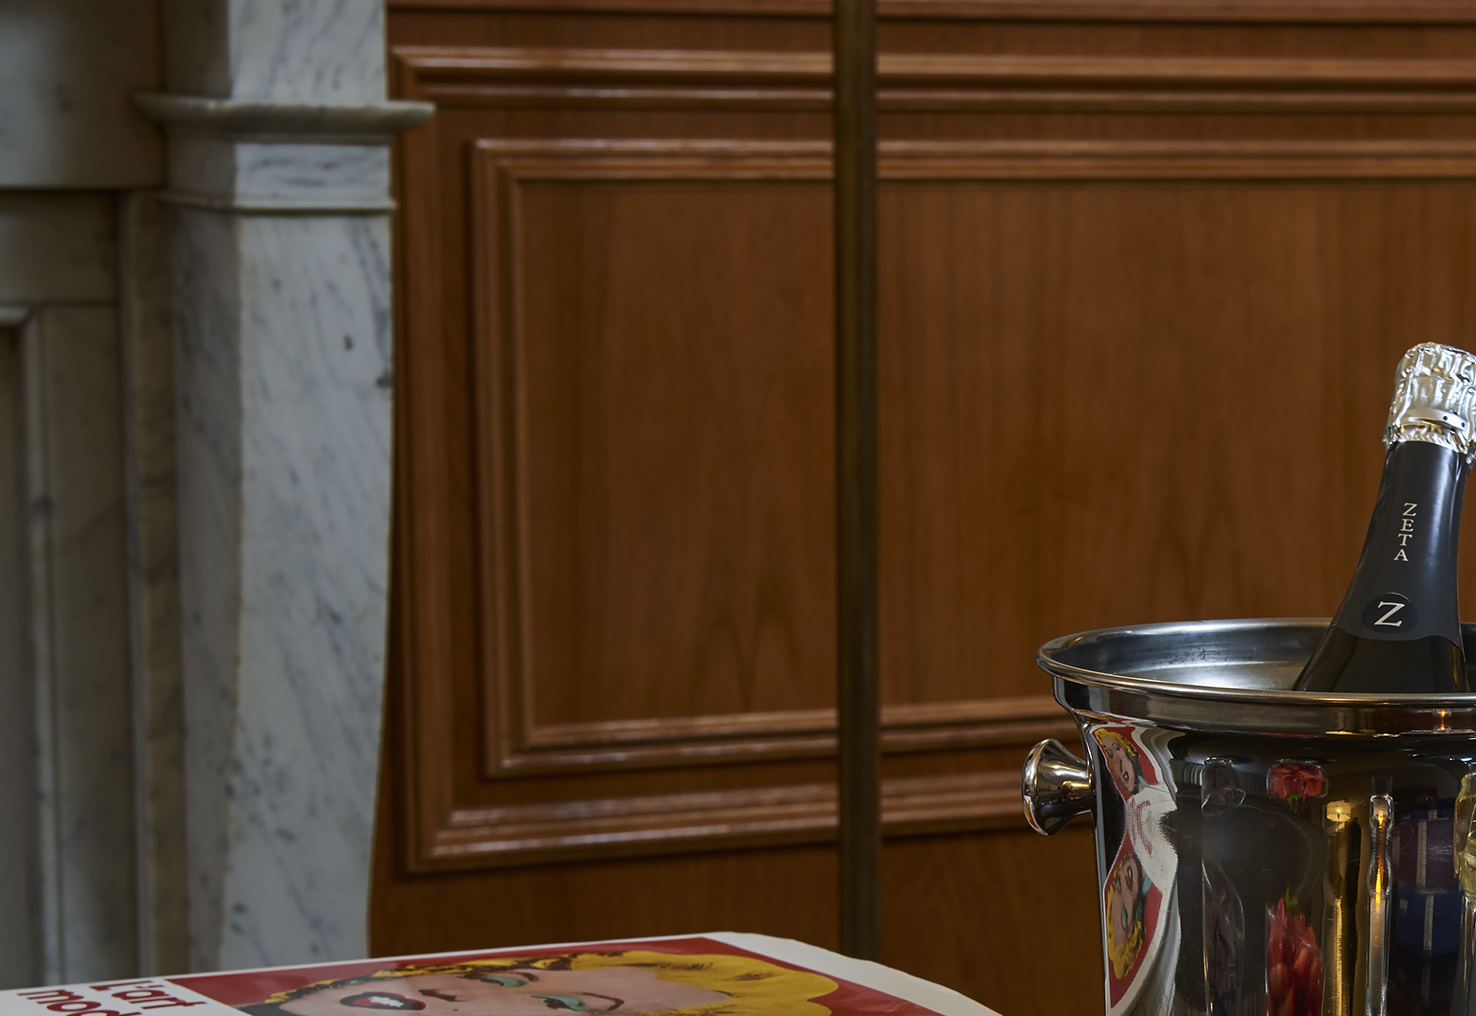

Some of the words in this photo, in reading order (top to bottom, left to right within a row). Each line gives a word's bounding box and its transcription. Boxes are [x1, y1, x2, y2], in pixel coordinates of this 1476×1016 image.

[1393, 502, 1418, 562] ZETA
[1373, 600, 1406, 628] Z
[89, 980, 208, 1010] L'art
